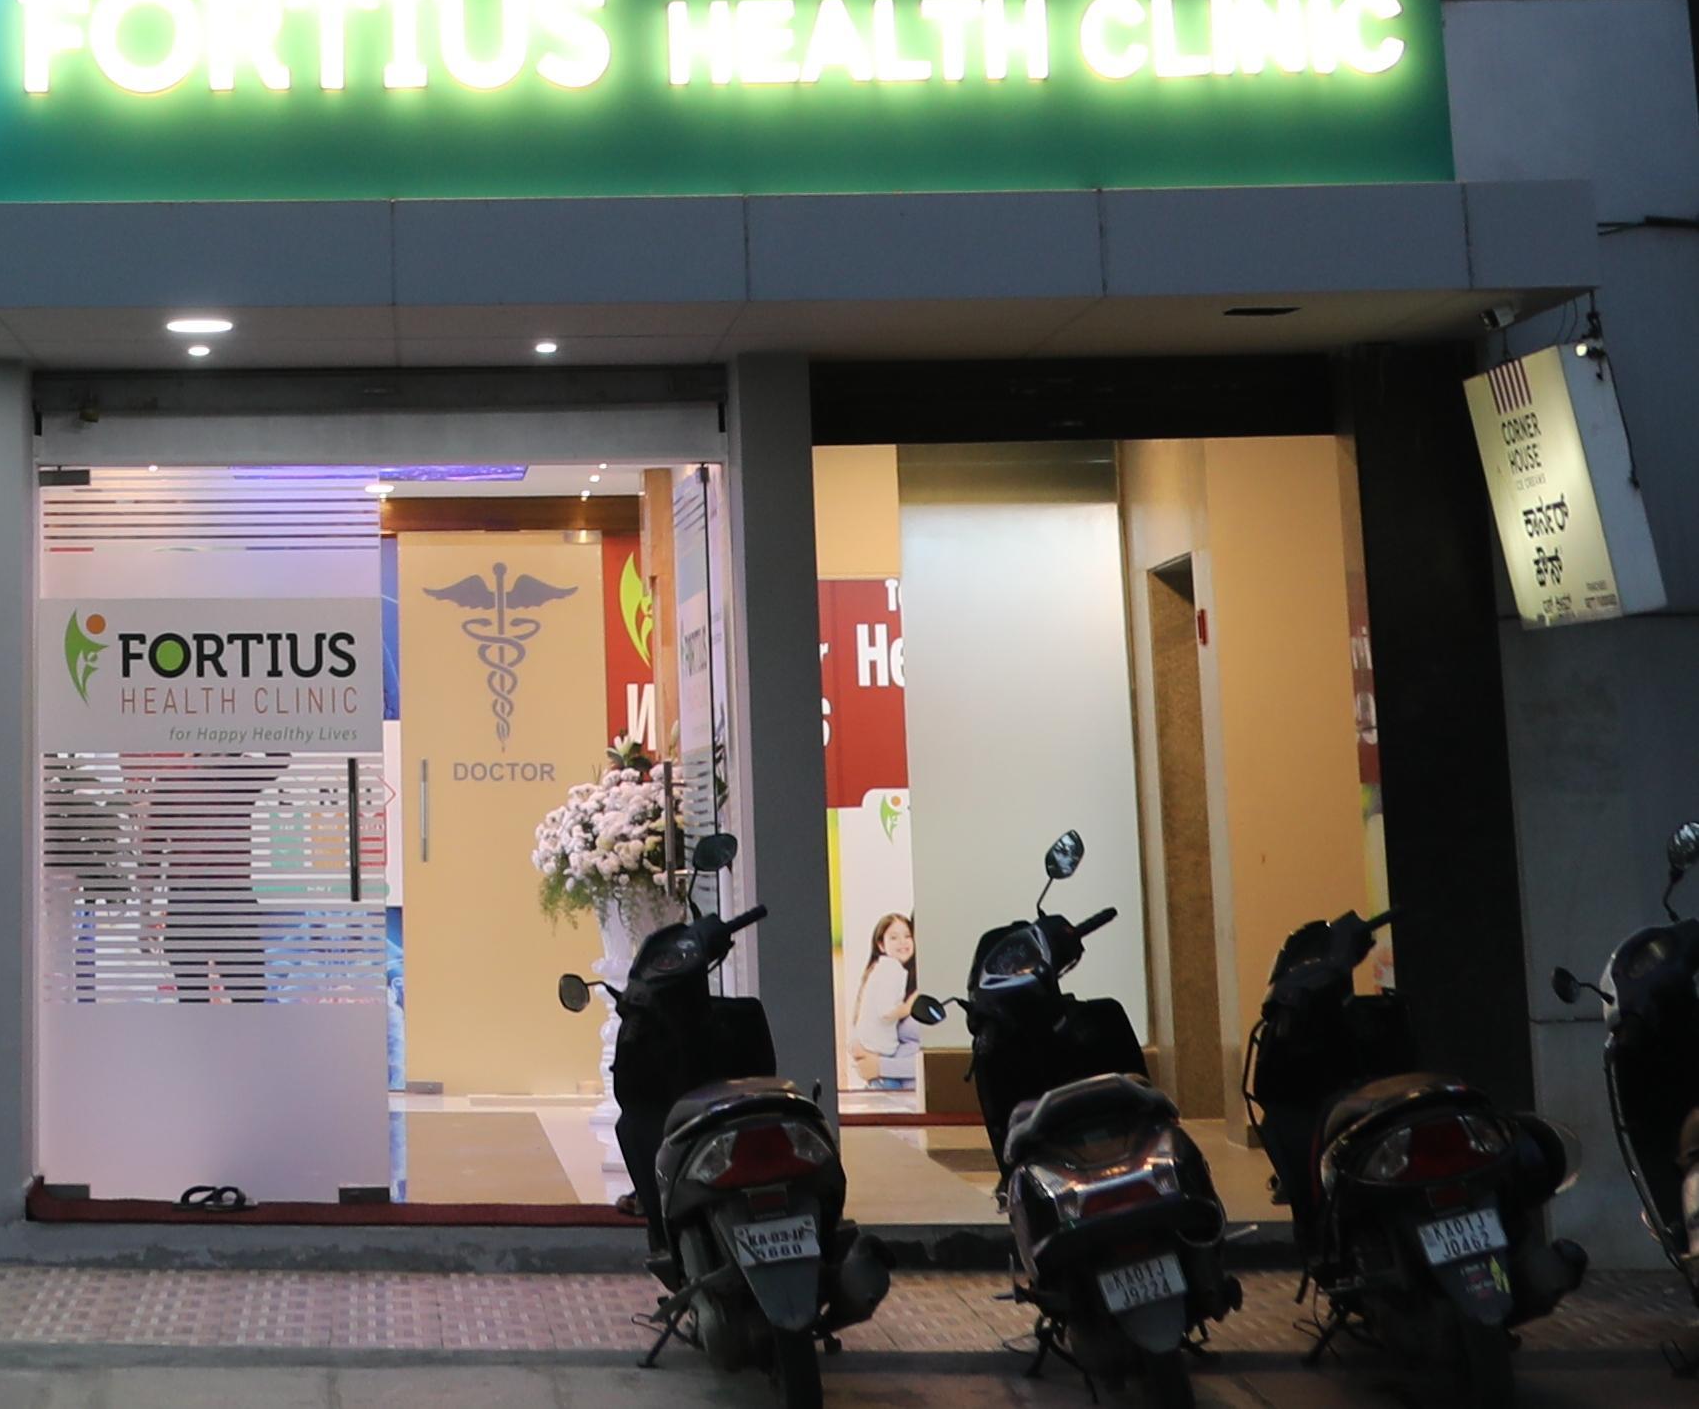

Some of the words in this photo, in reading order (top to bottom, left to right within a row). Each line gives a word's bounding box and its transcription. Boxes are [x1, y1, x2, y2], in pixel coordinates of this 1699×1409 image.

[1501, 412, 1541, 446] CORNER
[1508, 443, 1541, 475] HOUSE
[118, 632, 357, 678] FORTIUS
[121, 687, 236, 714] HEALTH
[254, 686, 358, 714] CLINIC
[168, 727, 191, 741] for
[197, 727, 247, 743] Happy
[252, 727, 314, 743] Healthy
[319, 727, 358, 741] Lives
[453, 762, 556, 782] DOCTOR
